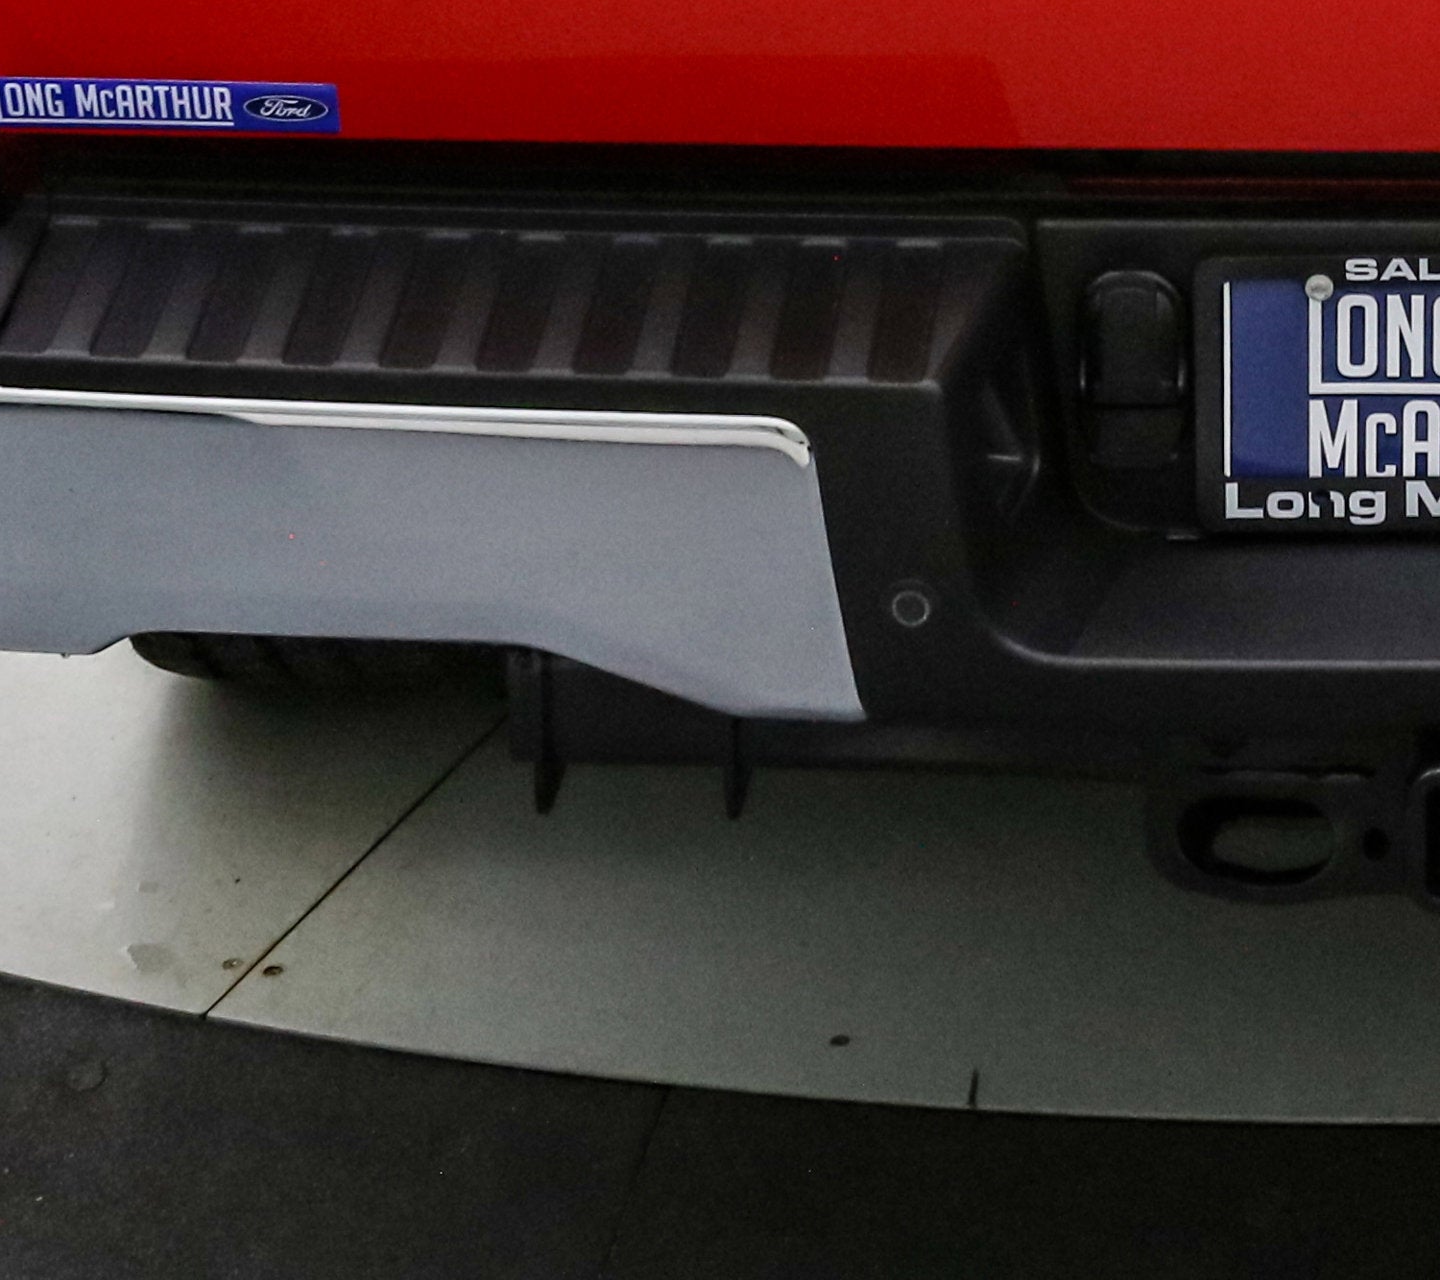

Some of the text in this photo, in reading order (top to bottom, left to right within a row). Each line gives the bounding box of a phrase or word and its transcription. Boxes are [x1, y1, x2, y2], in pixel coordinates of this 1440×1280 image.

[74, 84, 234, 121] McARTHUR
[260, 95, 312, 119] Ford
[1224, 482, 1388, 526] Long
